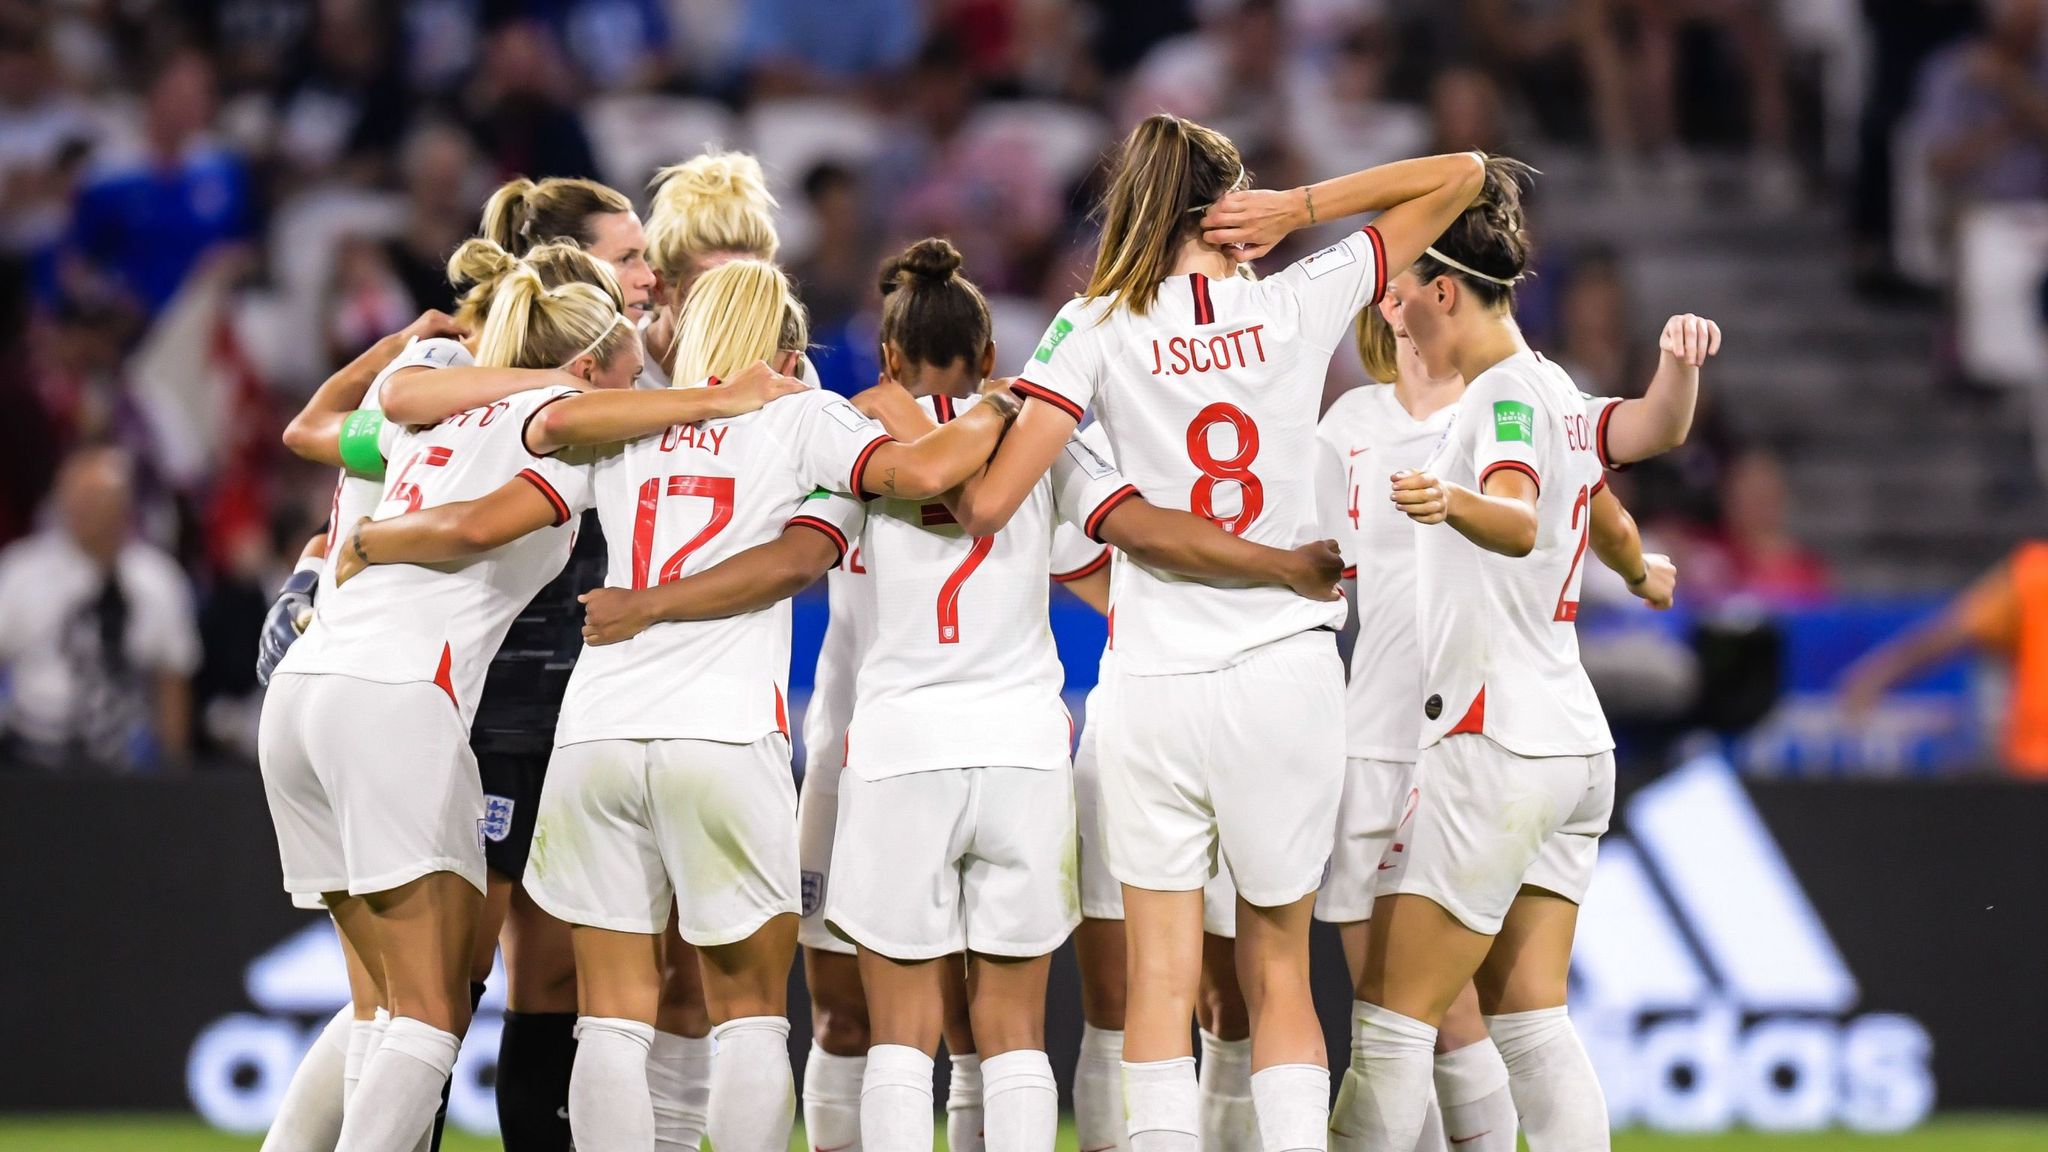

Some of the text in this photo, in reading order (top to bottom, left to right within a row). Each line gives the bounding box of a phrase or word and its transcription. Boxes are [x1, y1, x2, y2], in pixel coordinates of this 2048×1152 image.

[1151, 324, 1266, 376] J.SCOTT
[659, 421, 729, 456] DALY
[1186, 402, 1264, 537] 8
[631, 475, 736, 591] 17
[1348, 464, 1360, 531] 4
[1553, 484, 1588, 622] 2
[921, 503, 995, 644] 7
